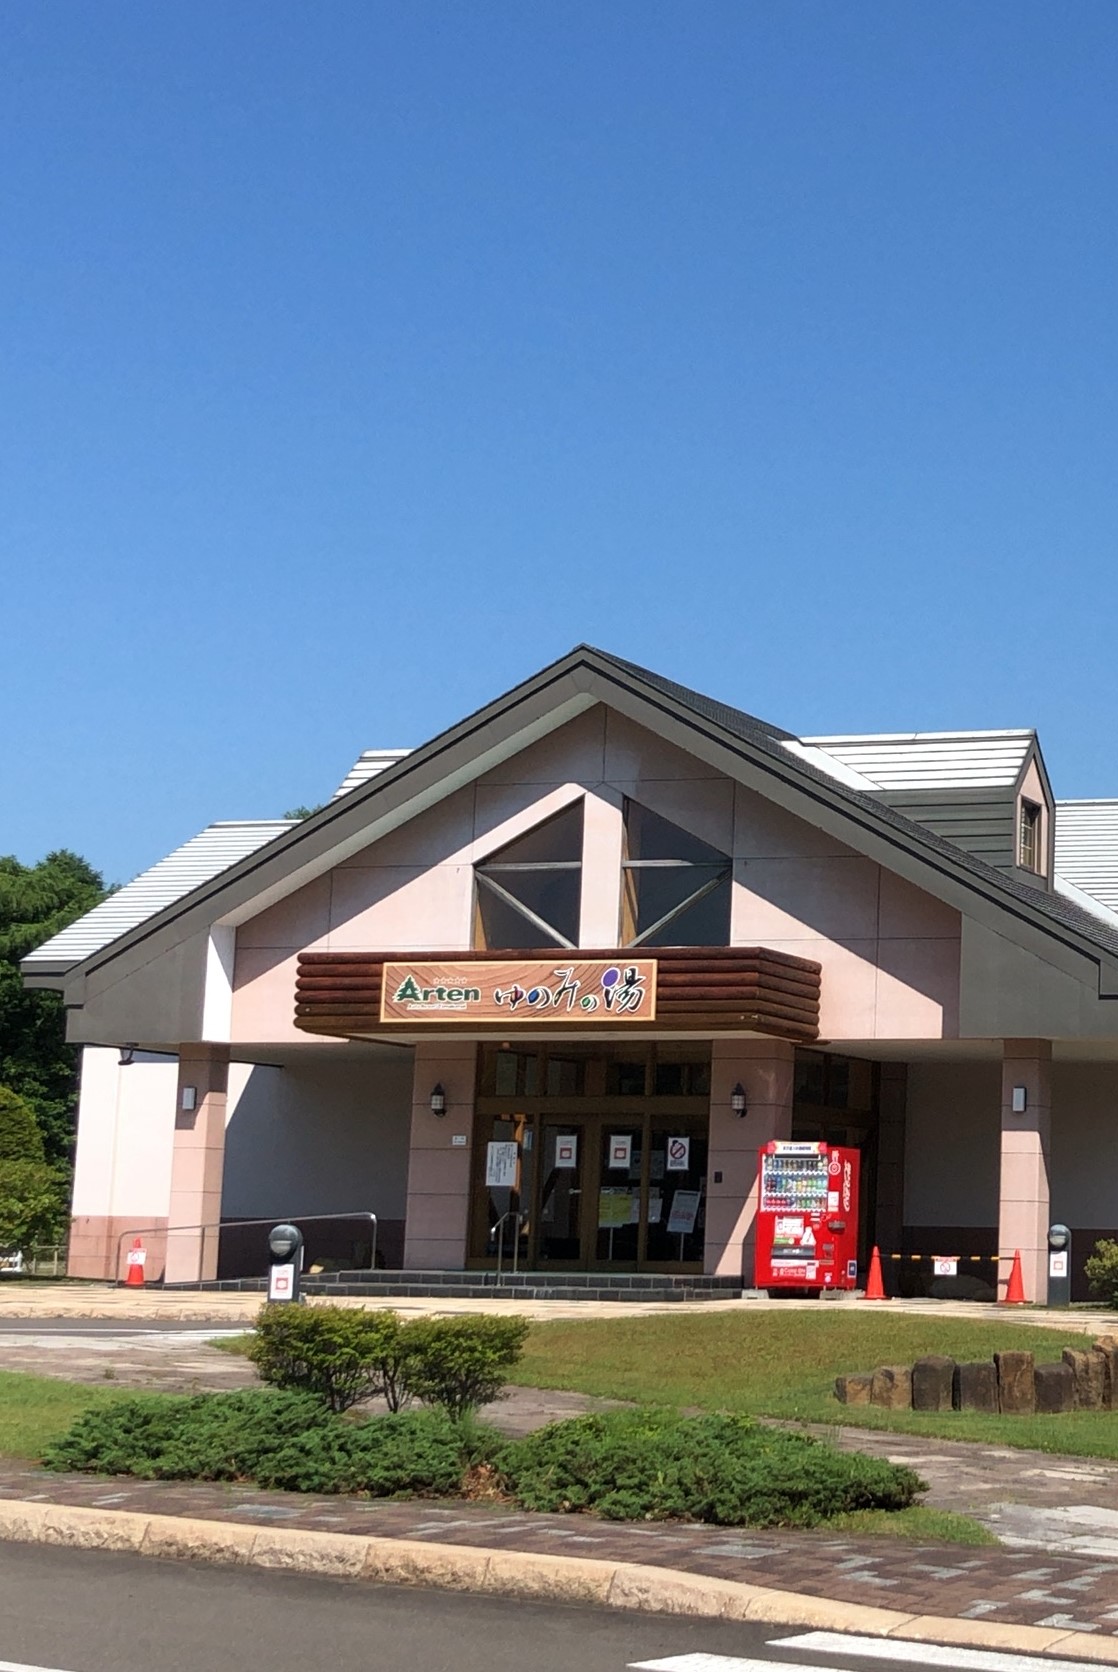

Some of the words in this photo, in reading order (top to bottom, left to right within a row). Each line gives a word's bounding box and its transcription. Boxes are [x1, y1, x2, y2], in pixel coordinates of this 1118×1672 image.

[395, 975, 481, 1002] Arten
[495, 967, 645, 1013] ゆのみの湯
